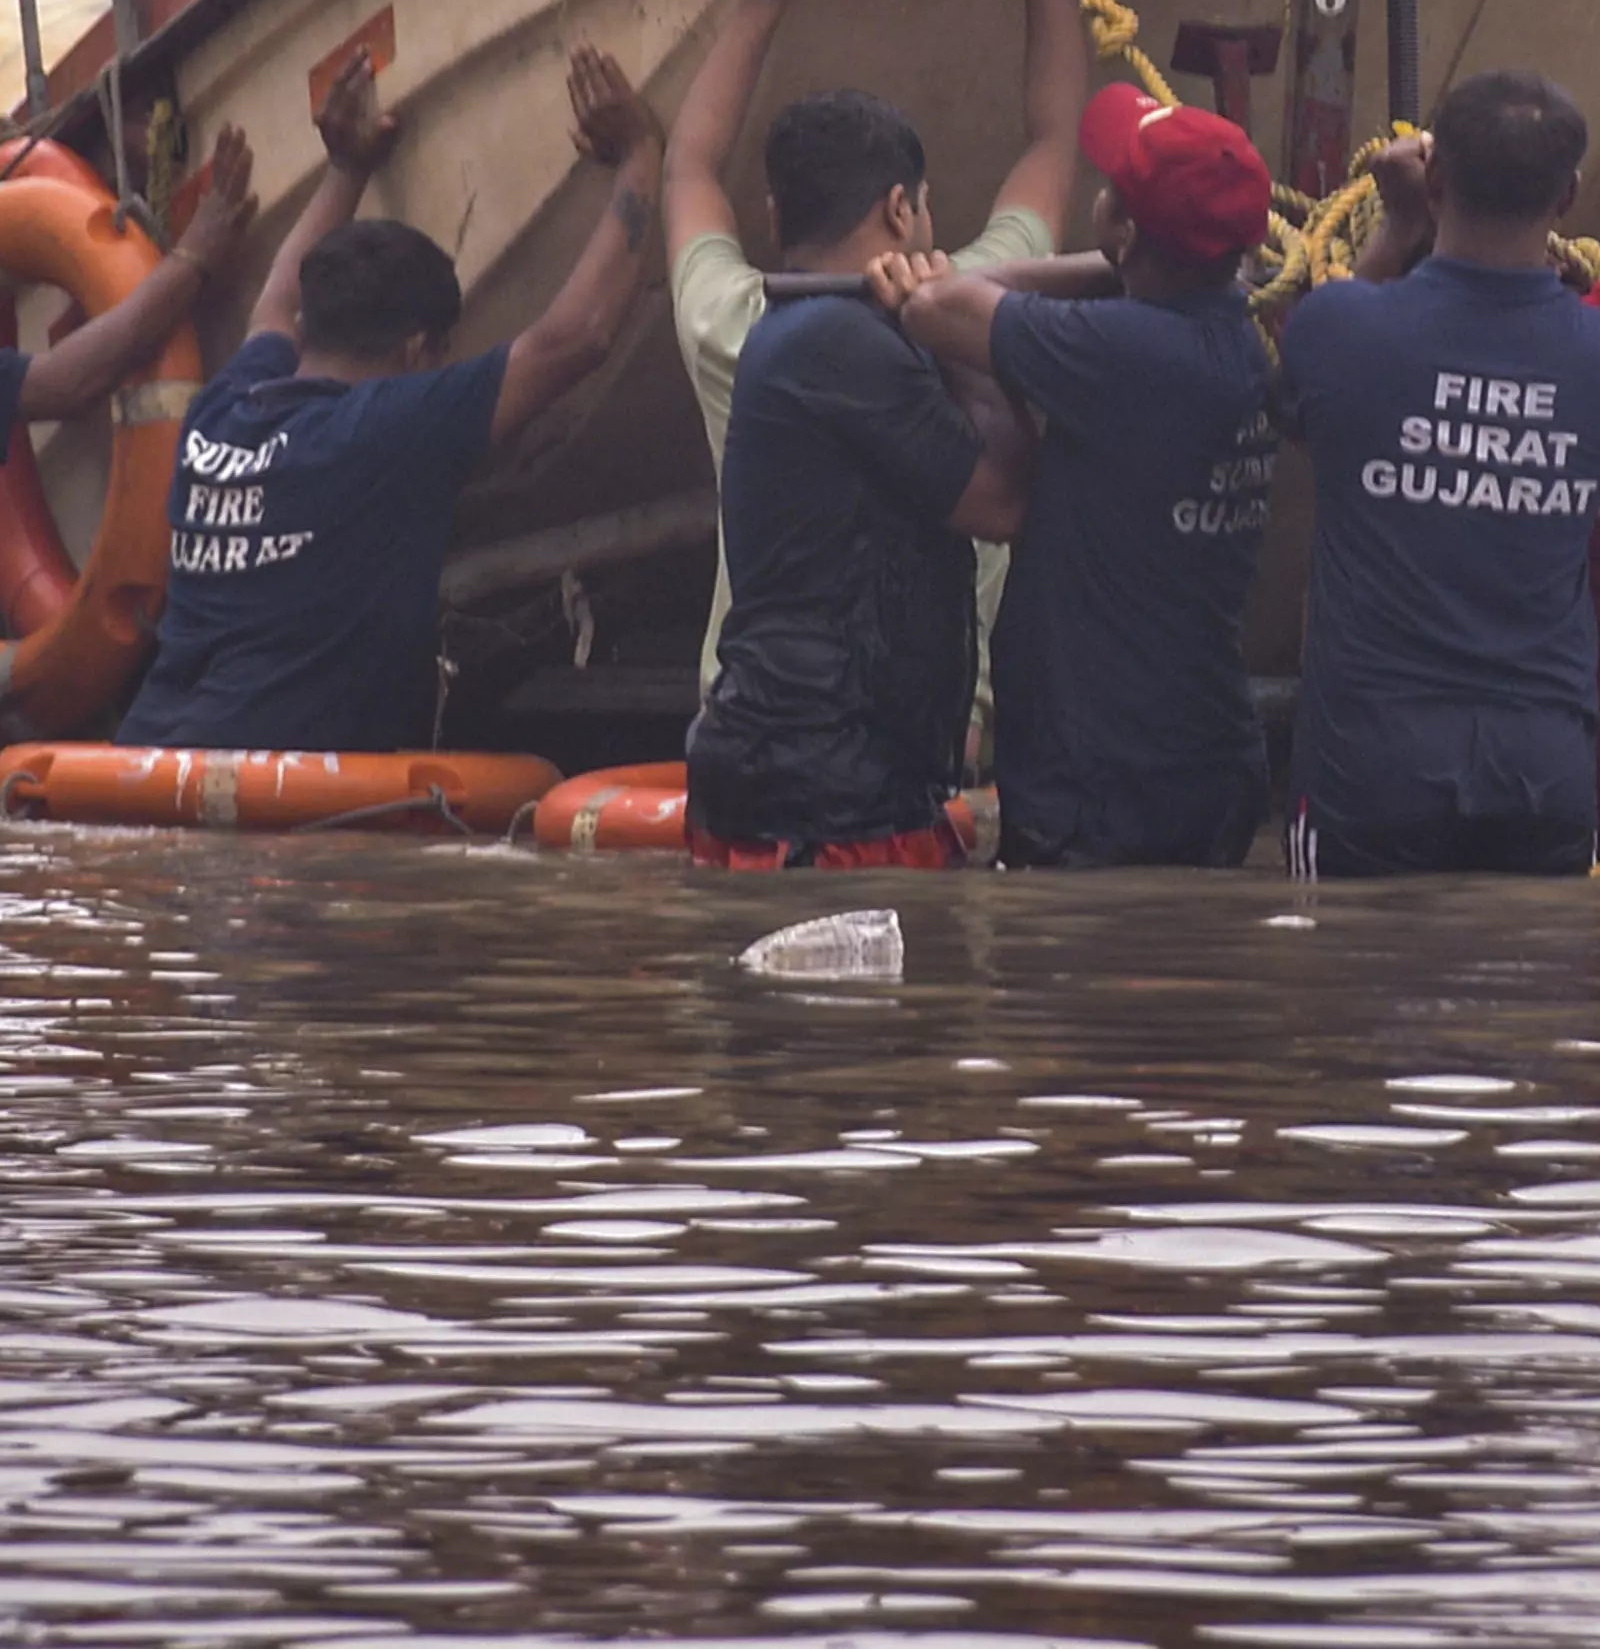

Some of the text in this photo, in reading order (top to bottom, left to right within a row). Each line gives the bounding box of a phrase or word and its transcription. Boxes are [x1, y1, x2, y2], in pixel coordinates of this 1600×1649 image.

[1434, 372, 1558, 419] FIRE
[1399, 416, 1578, 468] SURAT
[185, 483, 266, 527] FIRE
[1361, 459, 1598, 515] GUJARAT
